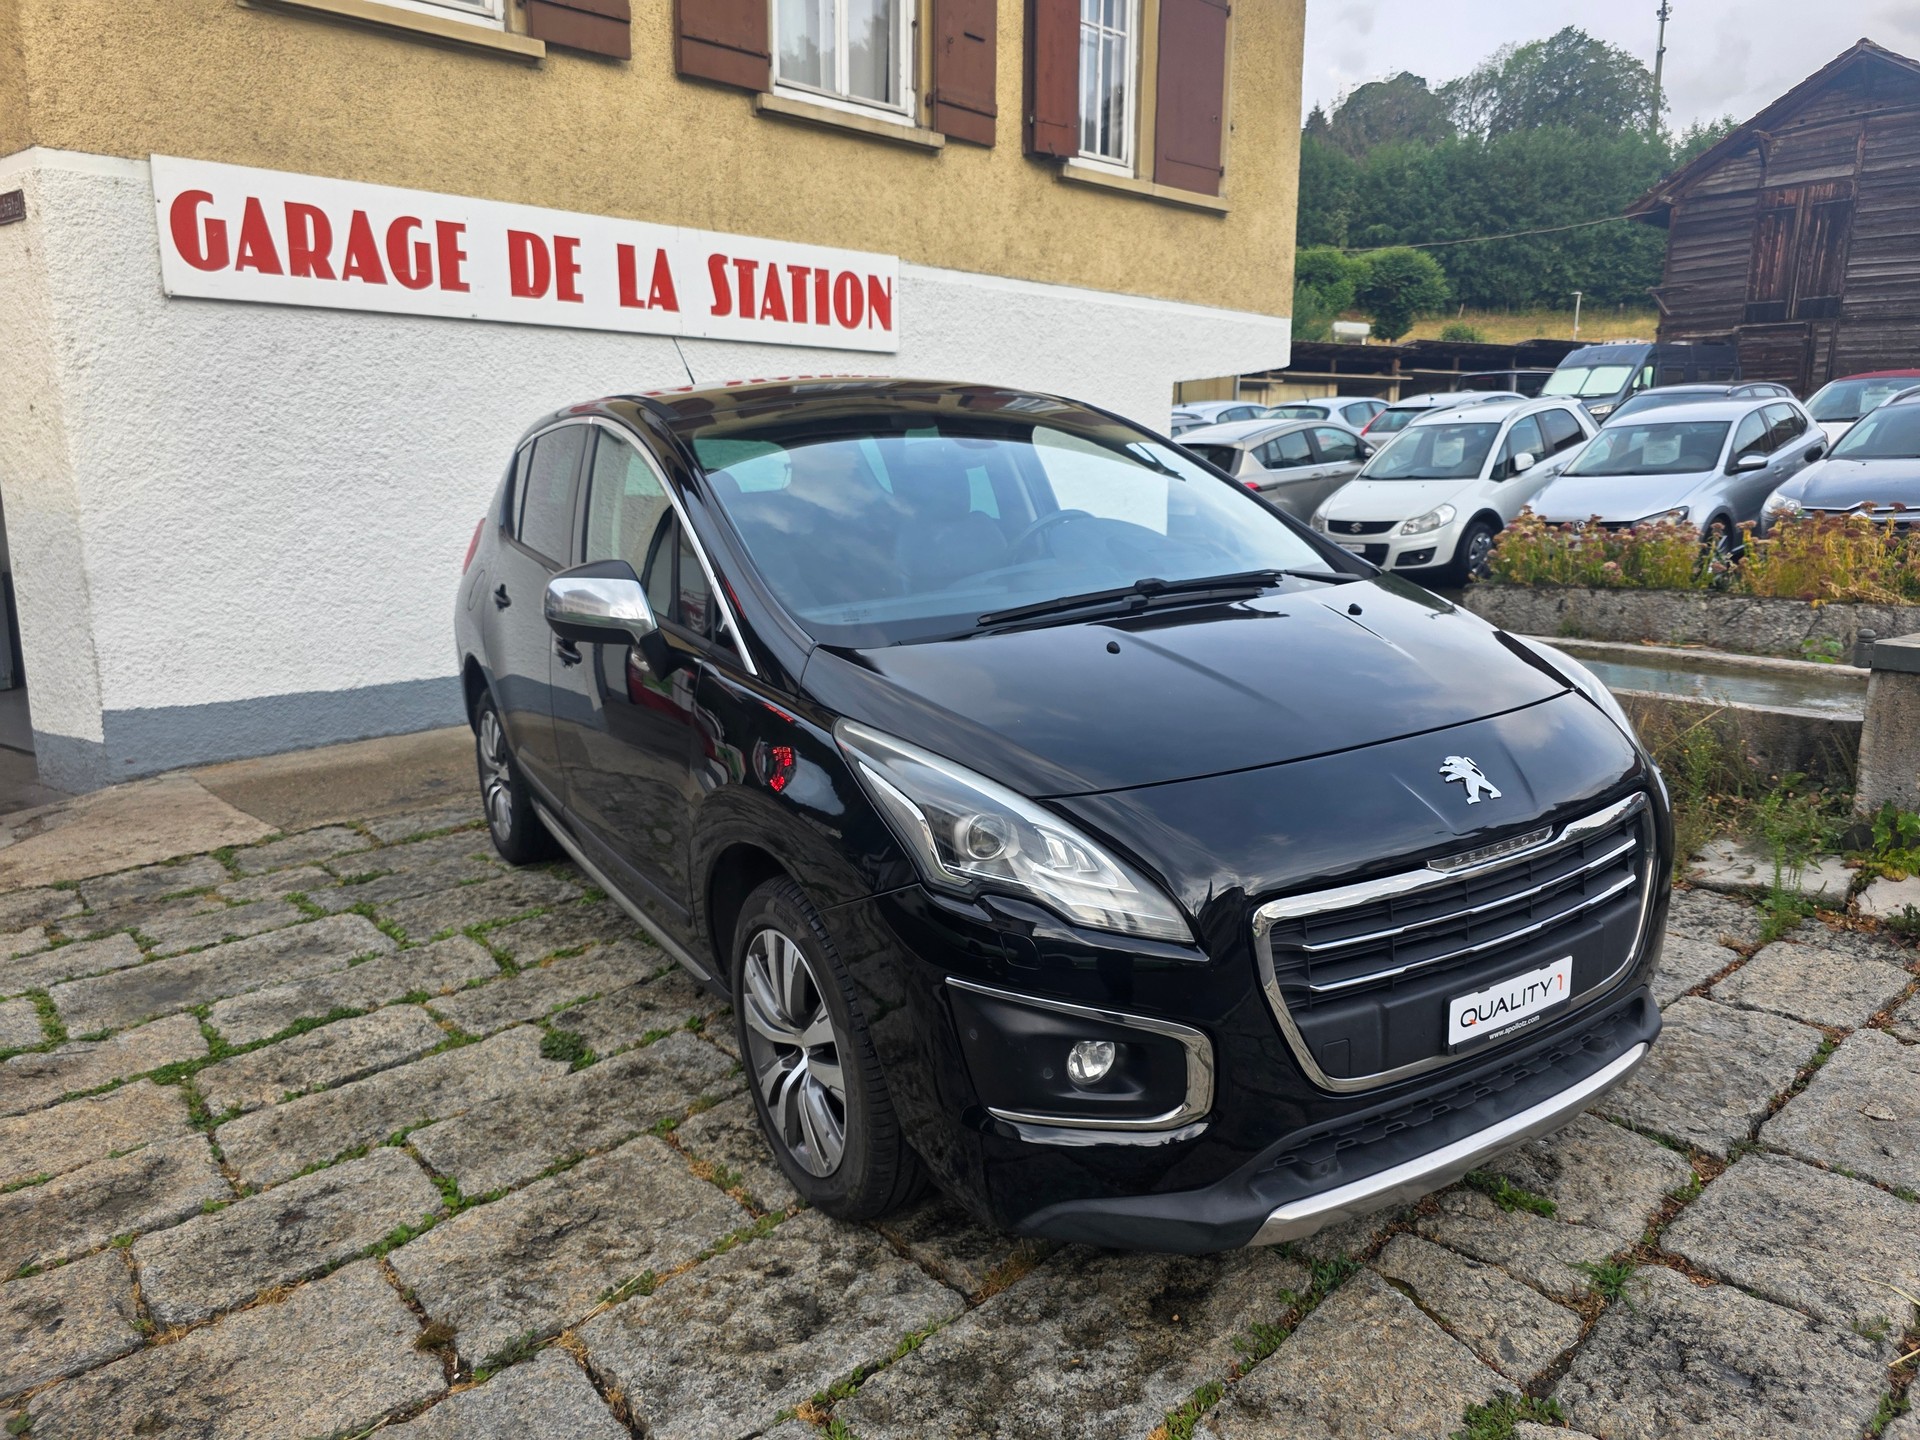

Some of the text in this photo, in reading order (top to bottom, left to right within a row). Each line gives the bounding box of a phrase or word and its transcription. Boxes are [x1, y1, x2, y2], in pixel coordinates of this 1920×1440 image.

[169, 189, 893, 332] GARAGE DE LA STATION
[1454, 832, 1540, 865] PEUGEOT
